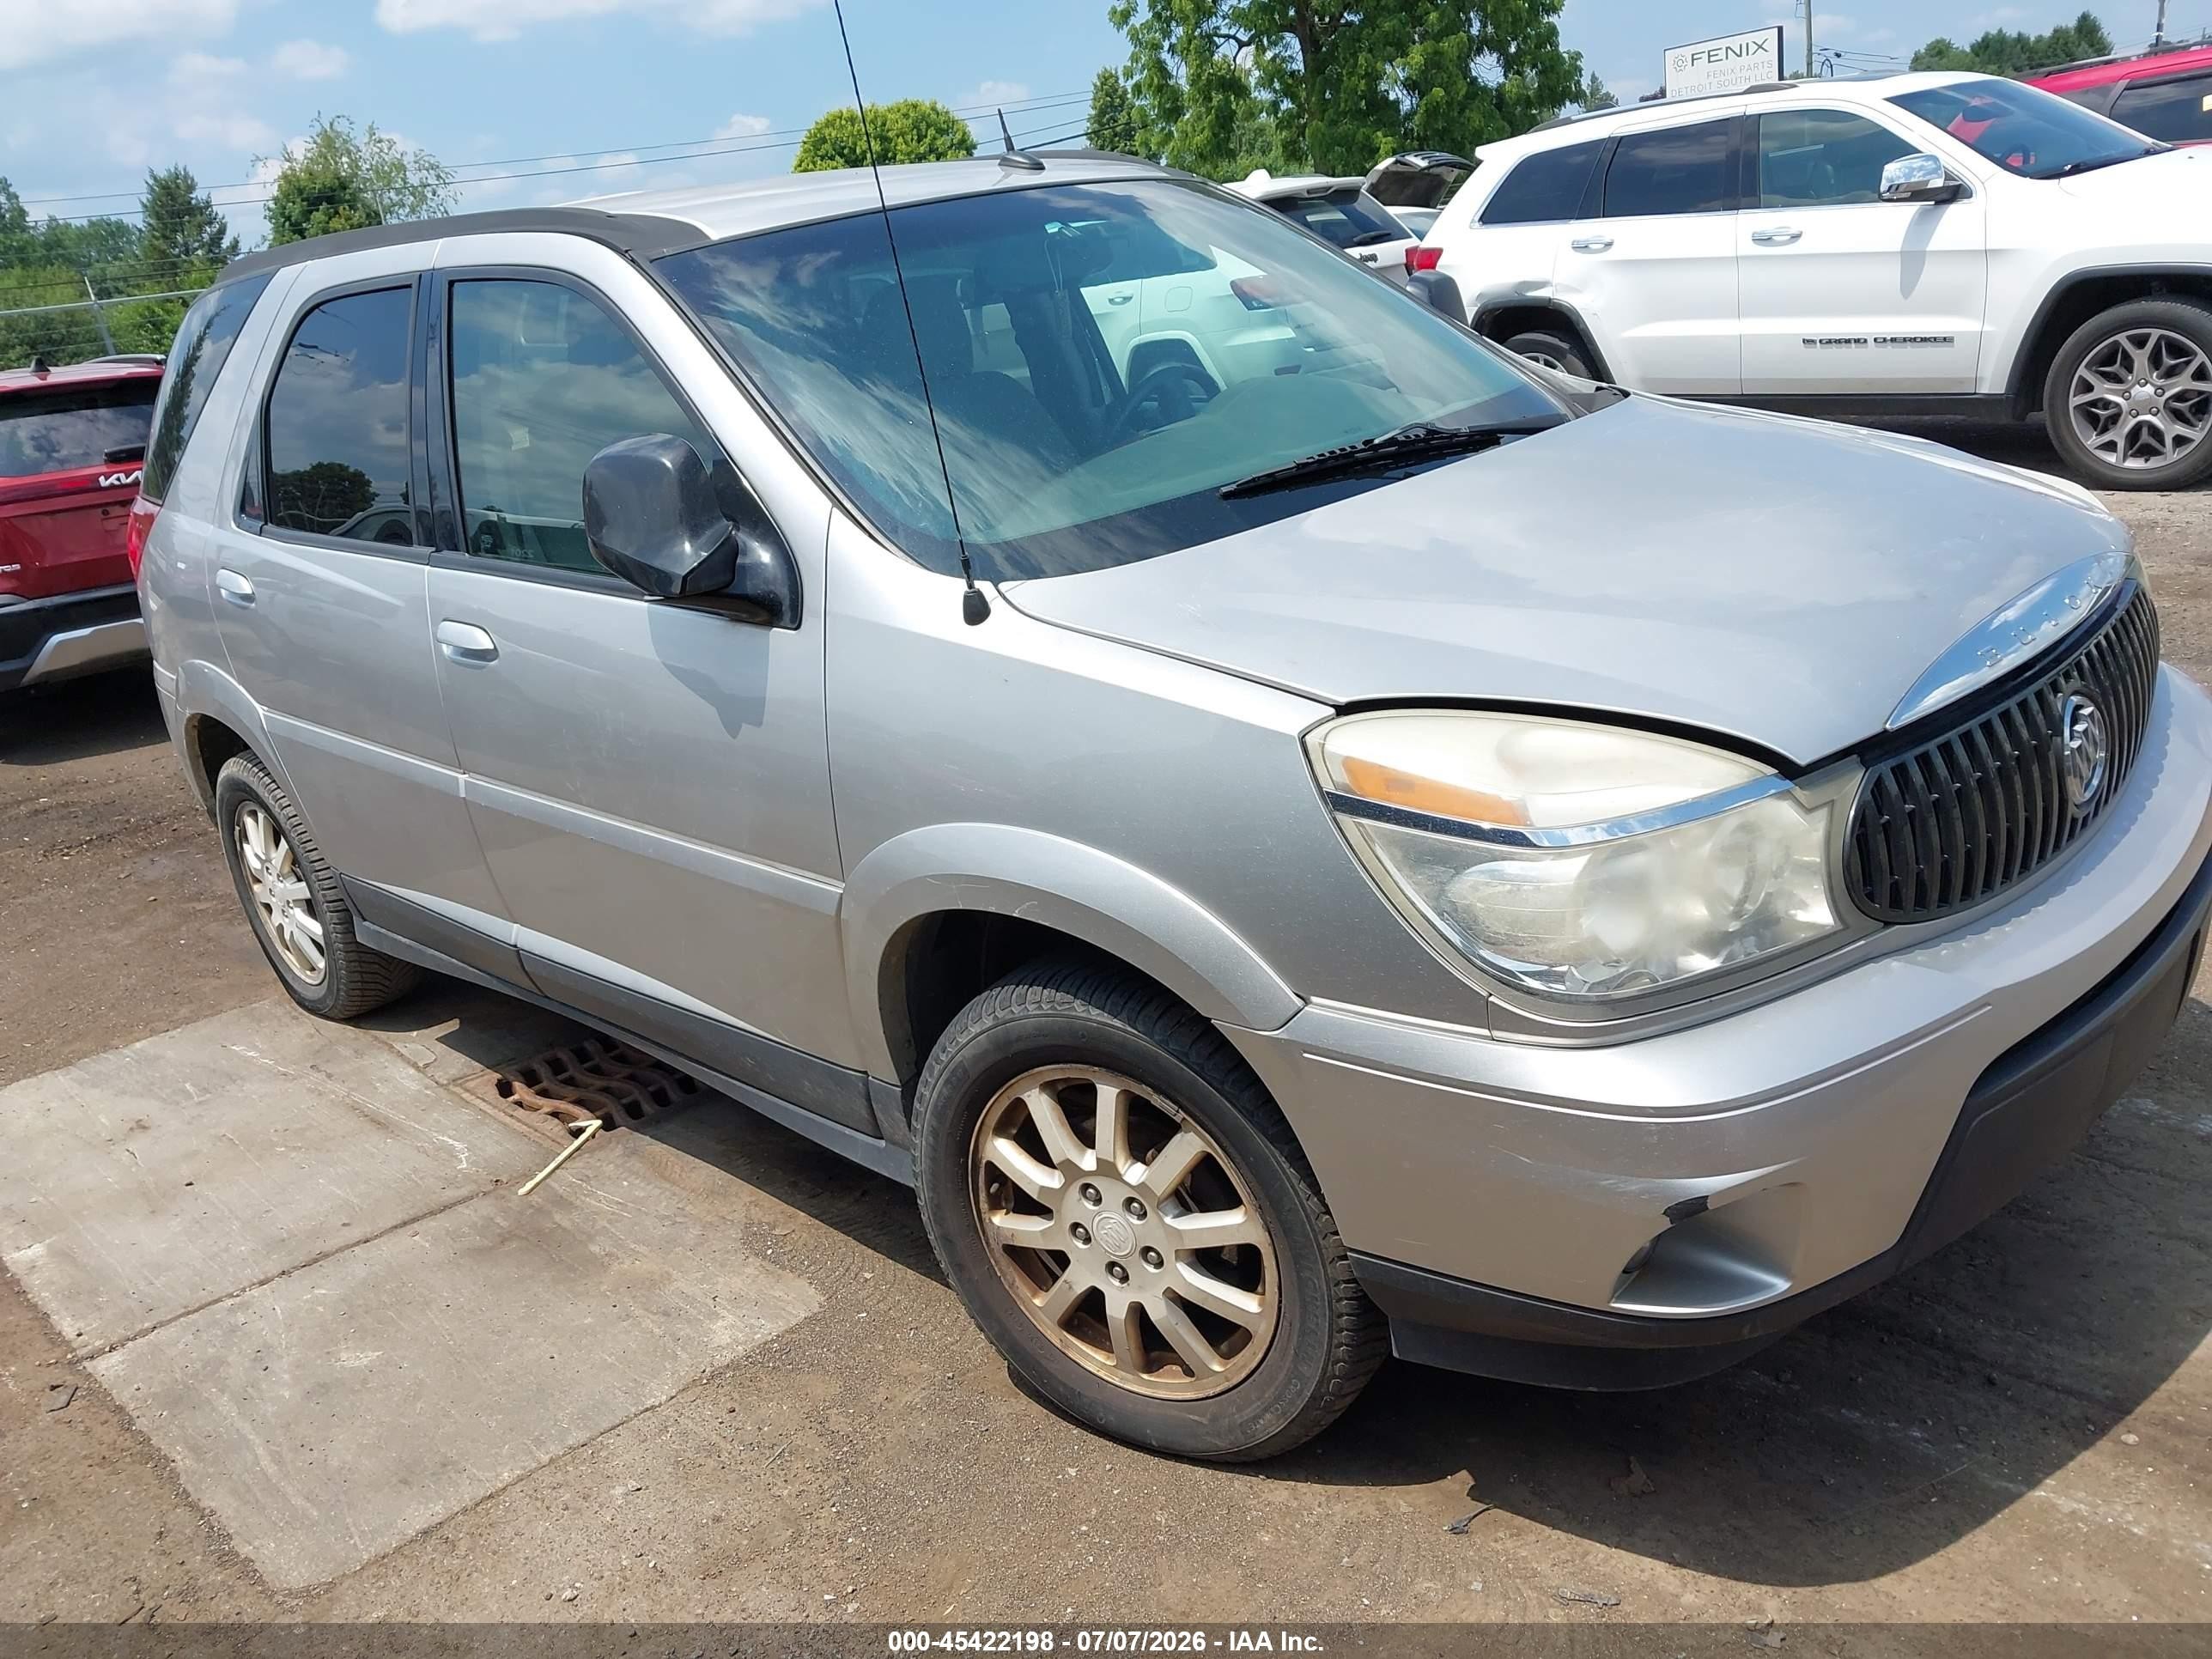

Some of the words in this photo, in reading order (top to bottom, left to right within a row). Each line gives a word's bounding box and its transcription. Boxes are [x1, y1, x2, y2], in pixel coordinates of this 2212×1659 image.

[1691, 38, 1770, 67] FENIX
[1706, 67, 1735, 79] FENIX
[1740, 60, 1773, 72] PARTS
[1671, 82, 1712, 97] DETROIT
[1717, 74, 1751, 88] SOUTH
[1754, 71, 1773, 82] LLC
[1873, 336, 1955, 344] CHEROKEE
[1976, 575, 2104, 668] BUICK
